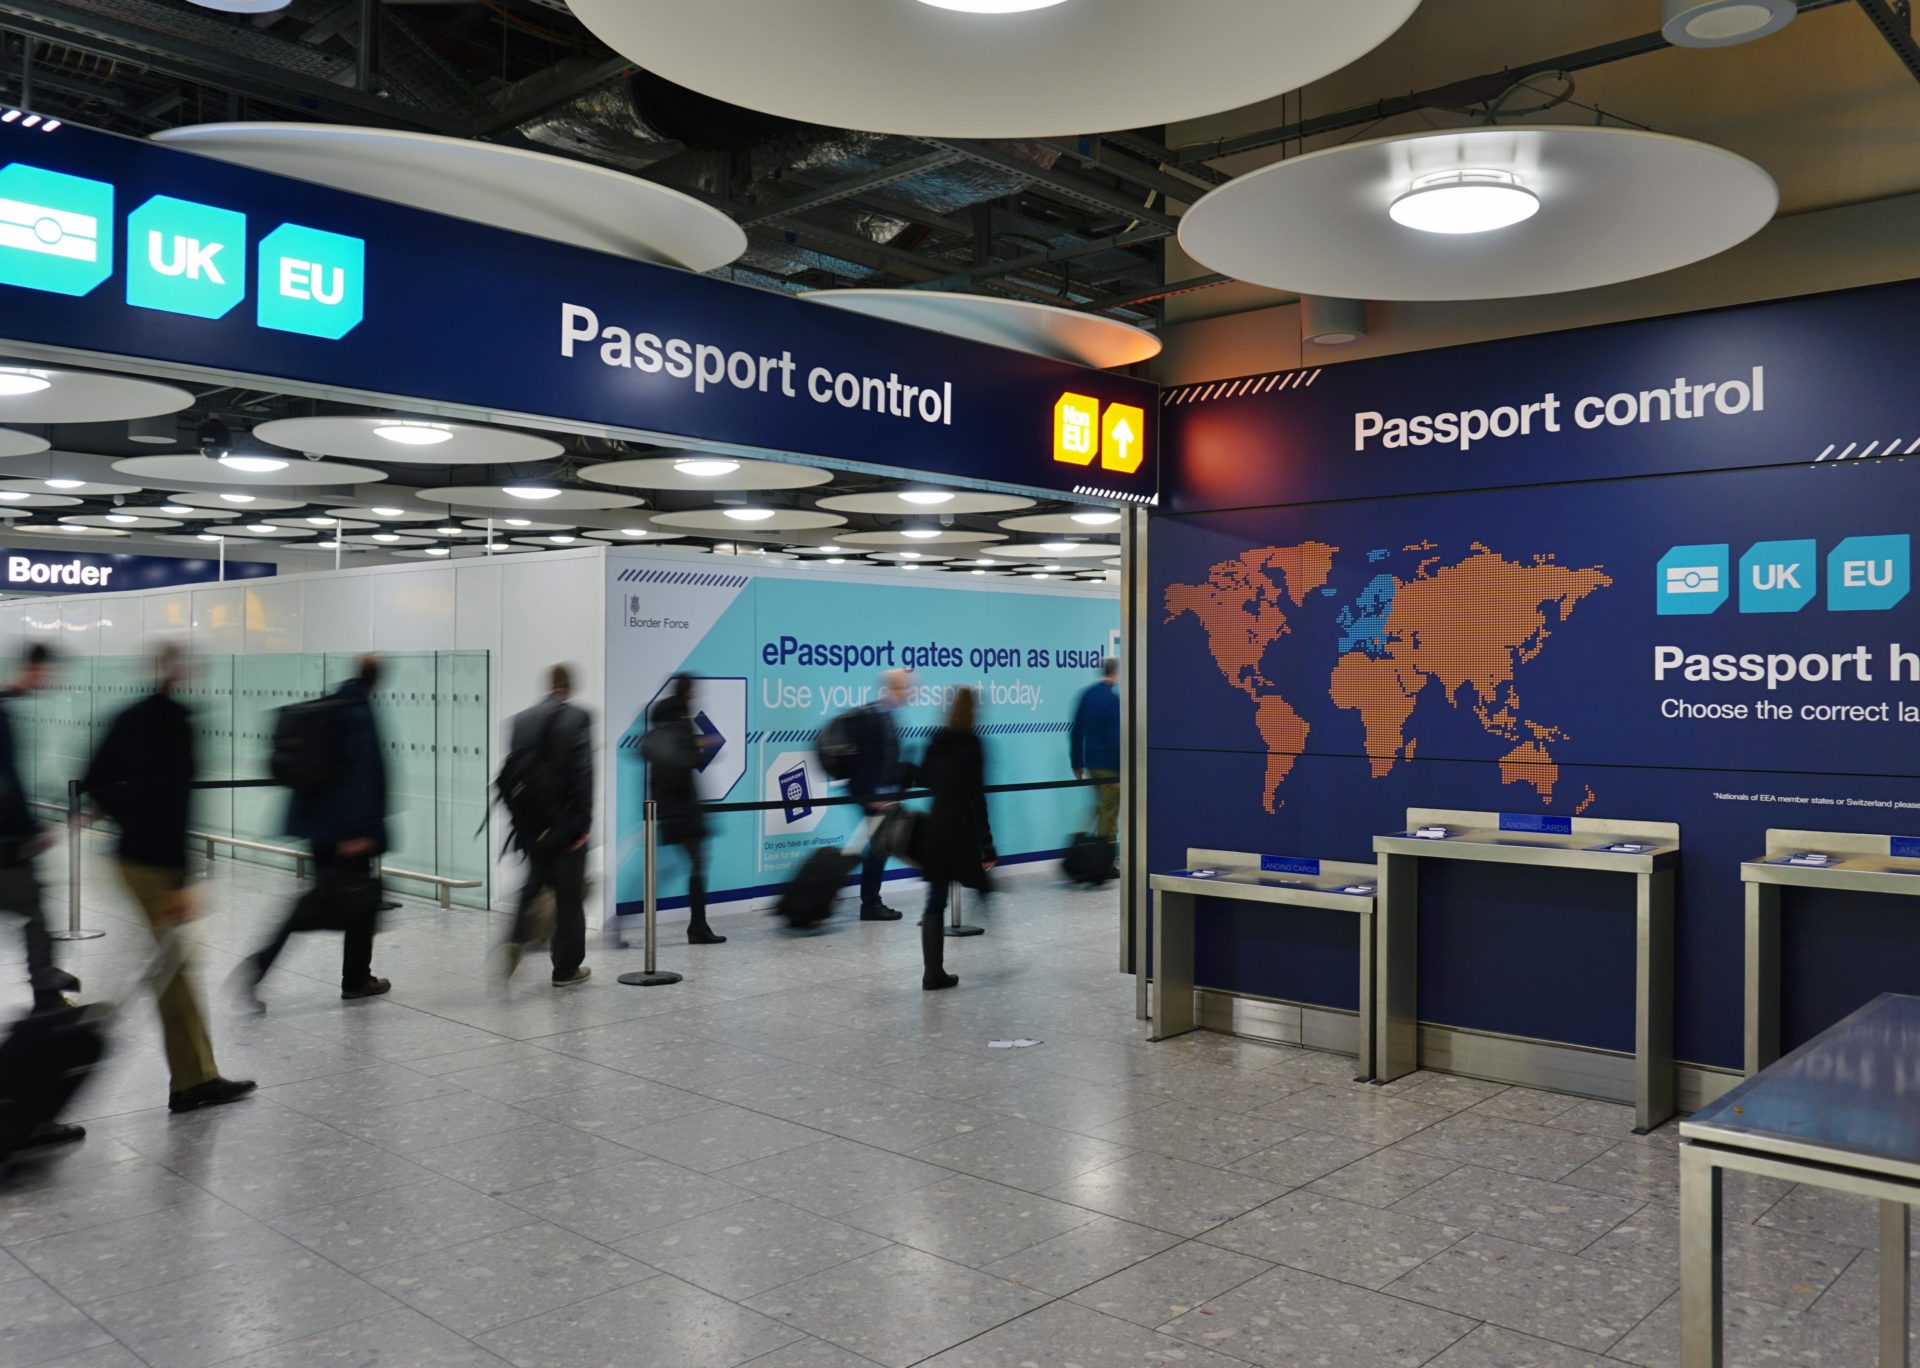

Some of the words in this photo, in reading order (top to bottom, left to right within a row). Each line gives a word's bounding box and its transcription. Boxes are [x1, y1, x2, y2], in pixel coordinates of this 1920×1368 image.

[149, 229, 225, 285] UK
[280, 256, 344, 305] EU
[561, 302, 795, 397] Passport
[808, 367, 952, 425] control
[1355, 393, 1560, 451] Passport
[1574, 366, 1764, 429] control
[1063, 424, 1090, 453] EU
[8, 556, 112, 586] Border
[1752, 563, 1802, 590] UK
[1843, 559, 1893, 587] EU
[630, 617, 662, 628] Border
[664, 618, 689, 629] Force
[762, 635, 895, 673] ePassport
[901, 641, 963, 673] gates
[969, 646, 1021, 673] open
[1027, 646, 1050, 668] as
[1654, 645, 1872, 689] Passport
[1890, 643, 1920, 681] h
[762, 678, 812, 709] Use
[819, 684, 872, 715] your
[878, 680, 985, 712] easspt
[989, 680, 1044, 711] today.
[1661, 699, 1748, 719] Choose
[1755, 700, 1792, 720] the
[1800, 702, 1889, 722] correct
[1778, 796, 1809, 804] member
[1811, 797, 1834, 805] states
[1846, 799, 1892, 808] Switzerland
[1501, 820, 1539, 830] LANDING
[1540, 824, 1569, 833] CARDS
[764, 841, 774, 850] Do
[774, 842, 786, 851] you
[1293, 864, 1318, 874] CARDS
